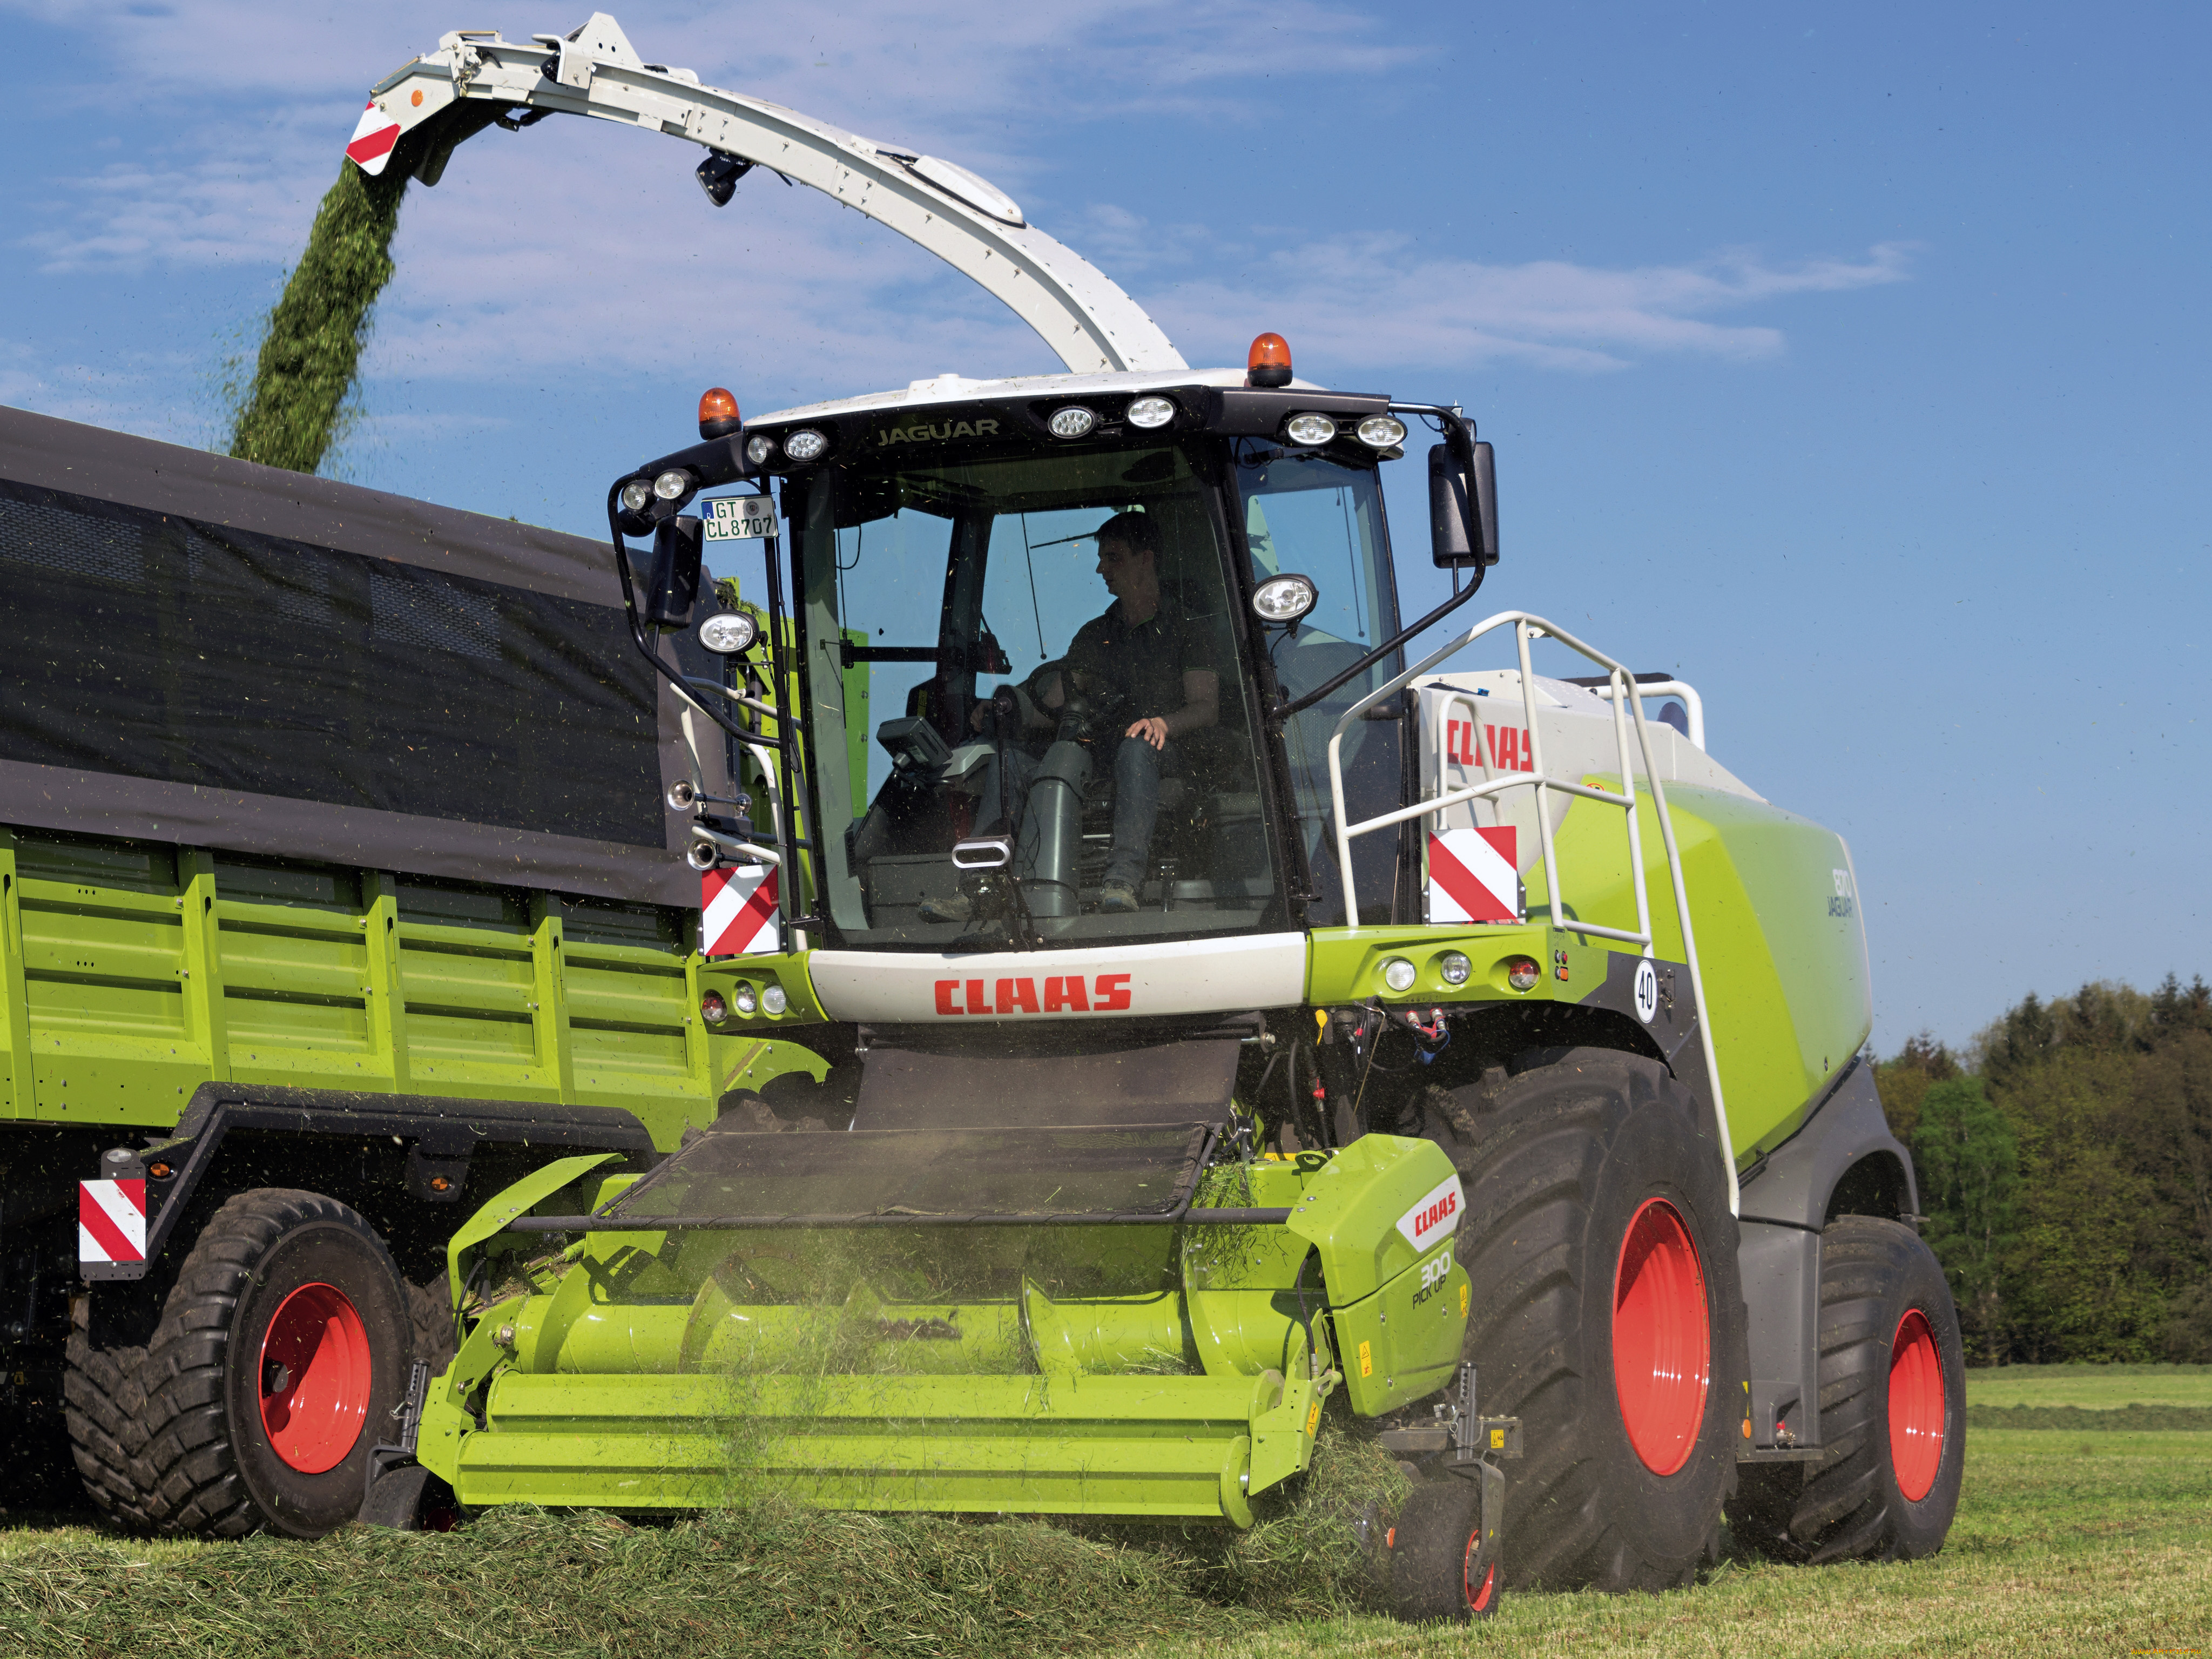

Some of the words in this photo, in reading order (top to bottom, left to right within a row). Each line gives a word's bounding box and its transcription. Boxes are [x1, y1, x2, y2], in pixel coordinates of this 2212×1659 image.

[878, 419, 999, 447] JAGUAR
[716, 501, 736, 518] GT
[1832, 868, 1852, 898] 870
[1827, 896, 1853, 918] JAGUAR
[934, 973, 1131, 1015] CLAAS
[1638, 970, 1653, 1010] 40
[1415, 1191, 1456, 1238] CLAAS
[1421, 1251, 1450, 1290] 300
[1412, 1283, 1432, 1310] PICK
[1434, 1273, 1446, 1293] UP
